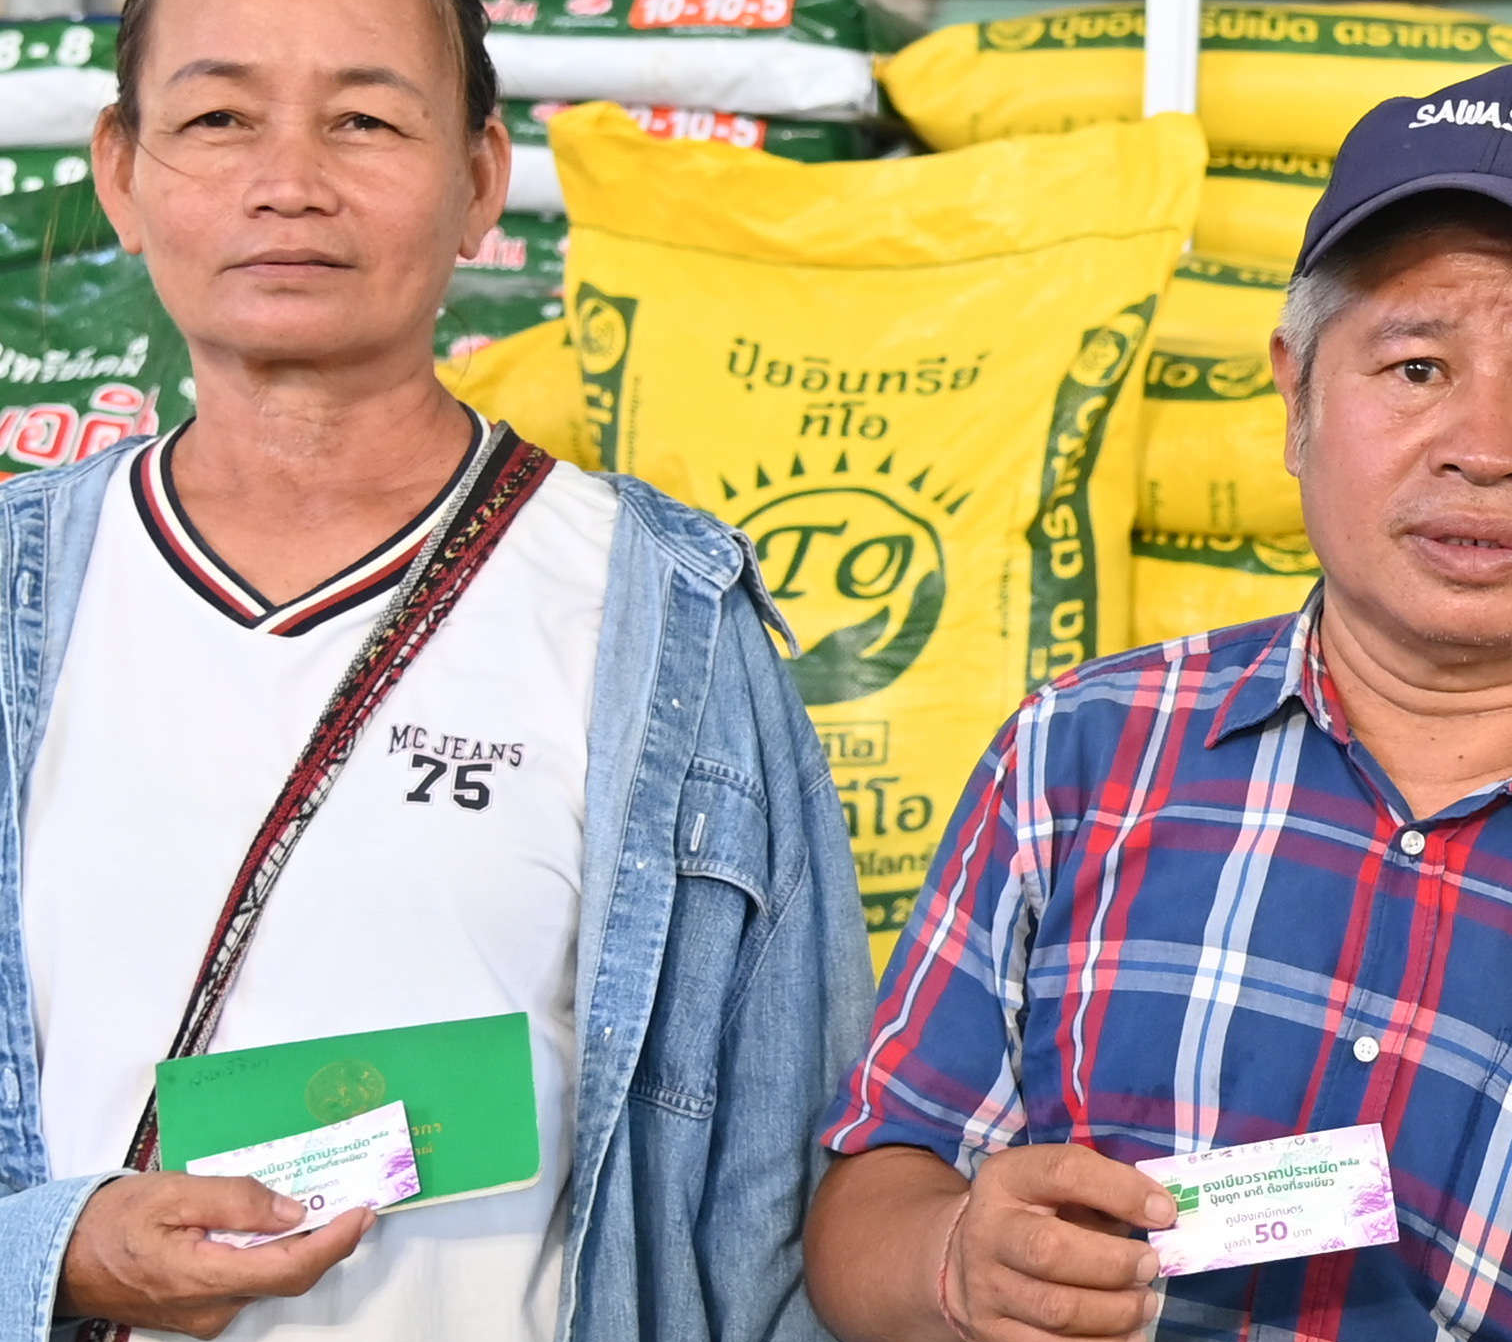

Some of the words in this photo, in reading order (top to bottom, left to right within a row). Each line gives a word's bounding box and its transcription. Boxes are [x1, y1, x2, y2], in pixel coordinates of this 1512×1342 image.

[726, 334, 990, 403] ปุ๋ยอินทรีย์
[799, 401, 891, 441] ทีโอ
[433, 733, 527, 769] JEANS
[404, 753, 495, 812] 75
[1202, 1159, 1339, 1194] ธงเขียวราคาประหยัด
[1254, 1219, 1289, 1246] 50
